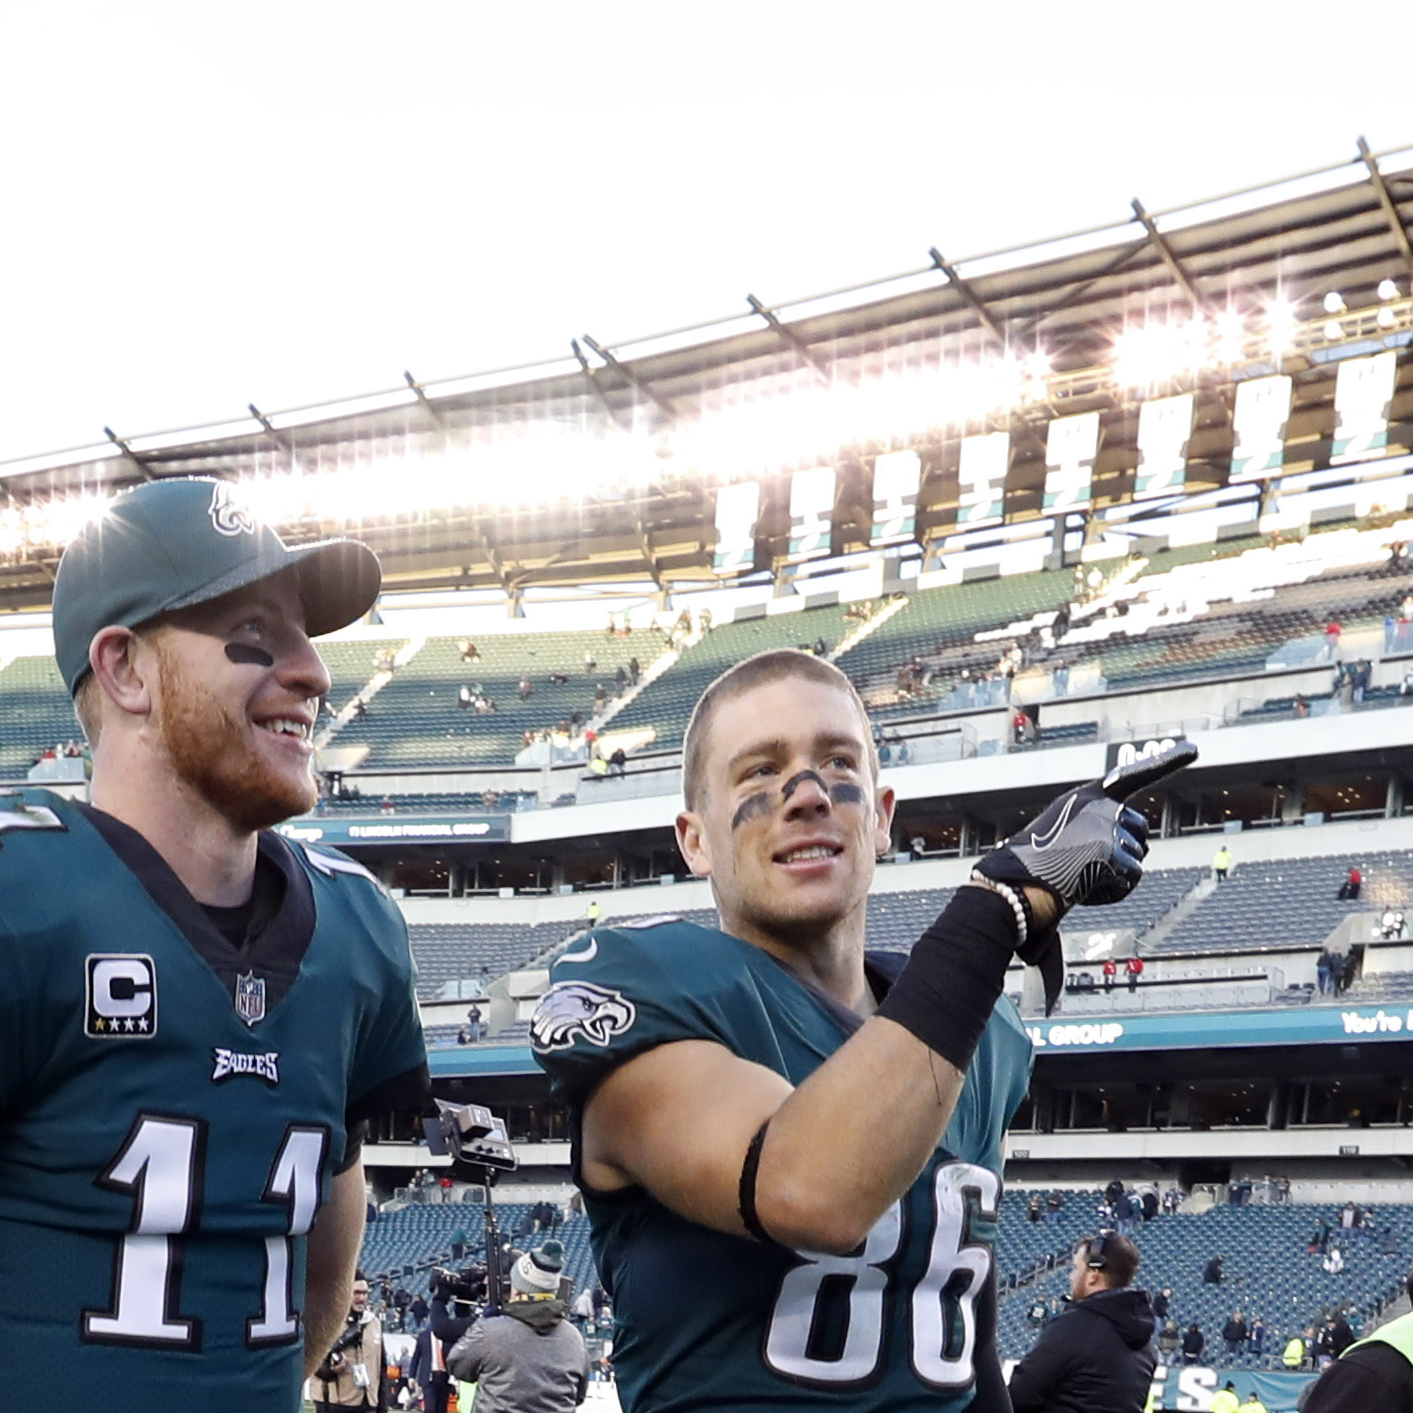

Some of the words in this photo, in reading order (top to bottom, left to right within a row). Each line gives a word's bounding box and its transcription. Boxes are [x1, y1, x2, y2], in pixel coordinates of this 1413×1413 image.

[93, 960, 151, 1017] C
[240, 995, 261, 1015] NFL
[1048, 1023, 1125, 1047] GROUP
[1340, 1011, 1402, 1034] You're
[212, 1047, 279, 1084] EAGLES
[83, 1113, 330, 1349] 11
[764, 1161, 1002, 1386] 86
